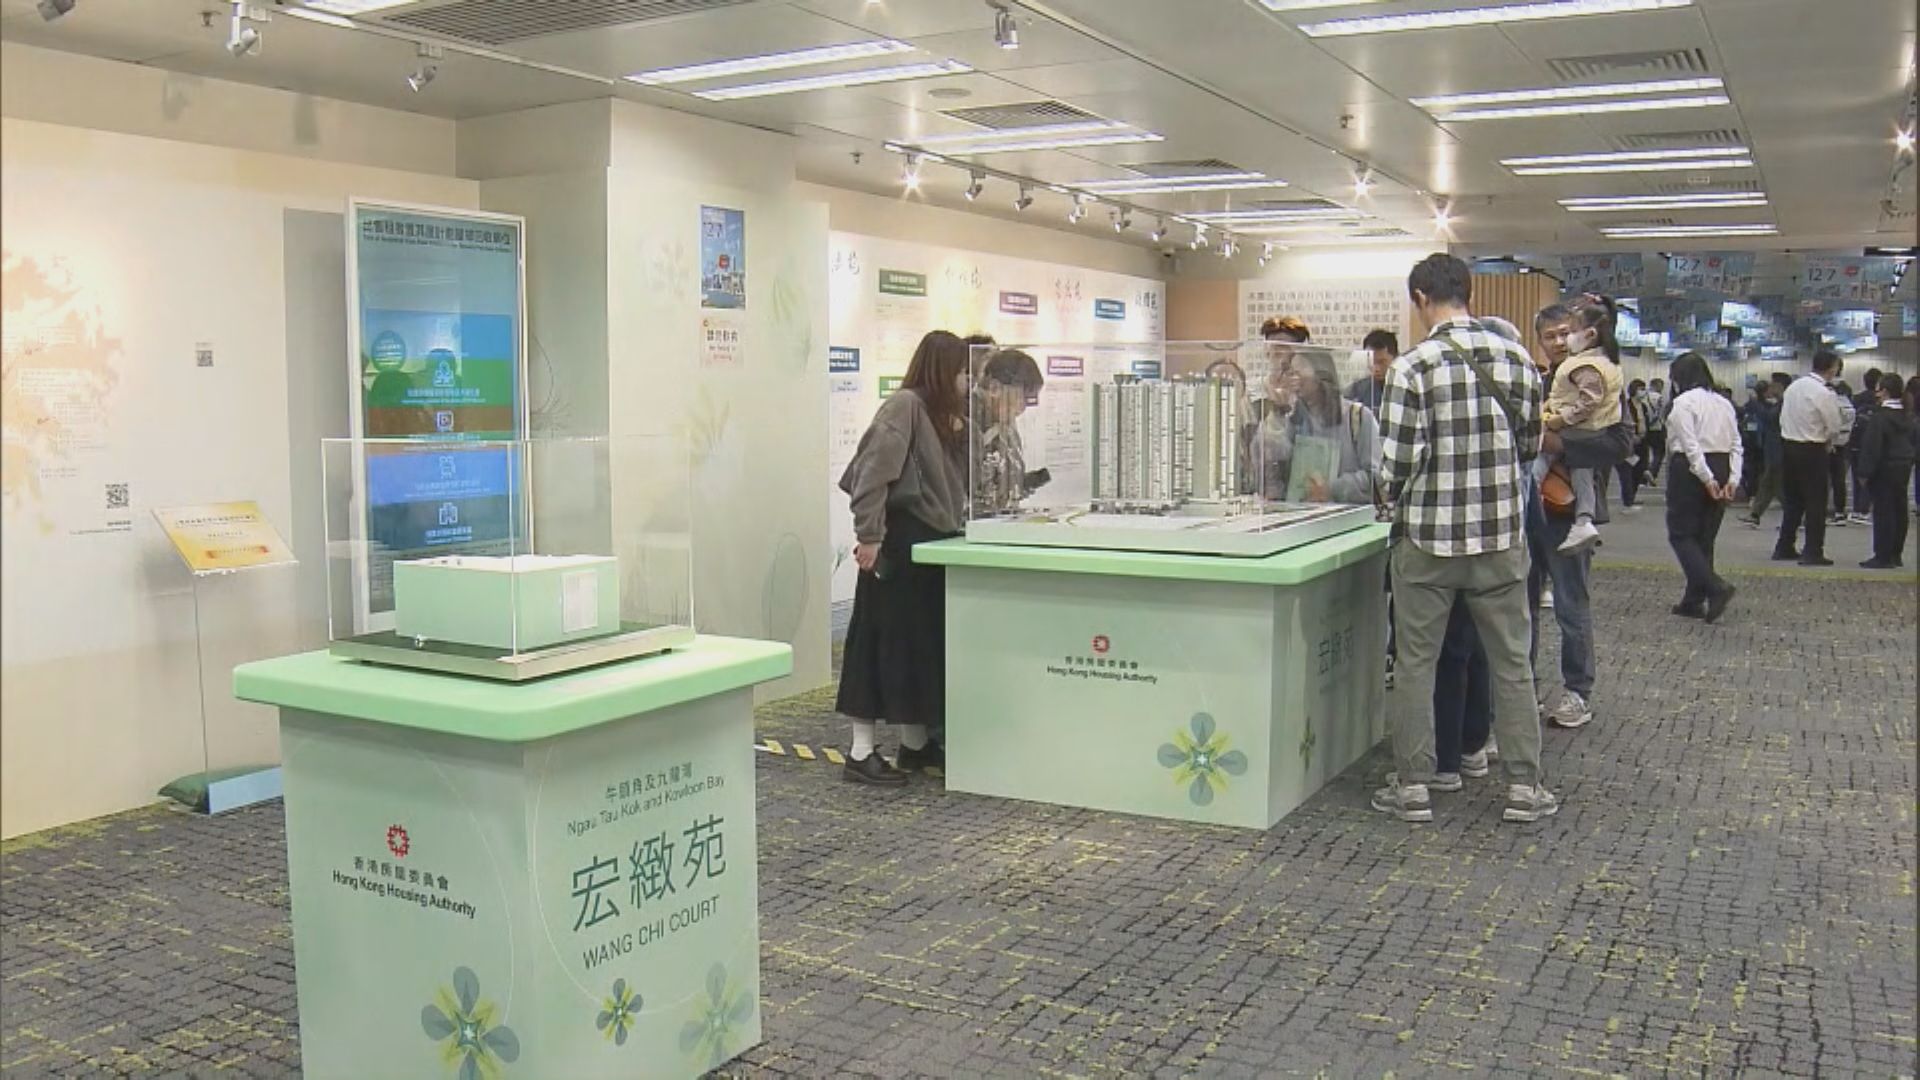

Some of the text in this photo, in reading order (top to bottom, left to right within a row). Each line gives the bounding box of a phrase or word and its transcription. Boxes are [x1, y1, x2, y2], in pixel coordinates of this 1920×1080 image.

[1047, 666, 1157, 685] Hong Kong Housing Authority
[606, 761, 692, 801] 牛頭角及九龍灣
[567, 775, 724, 837] Ngau Tau Kok and Kowloon Bay
[333, 870, 476, 919] Hong Kong Housing Authority
[354, 856, 449, 892] 香港房屋委員會
[572, 814, 727, 932] 宏緻苑
[583, 894, 720, 970] WANG CHI COURT
